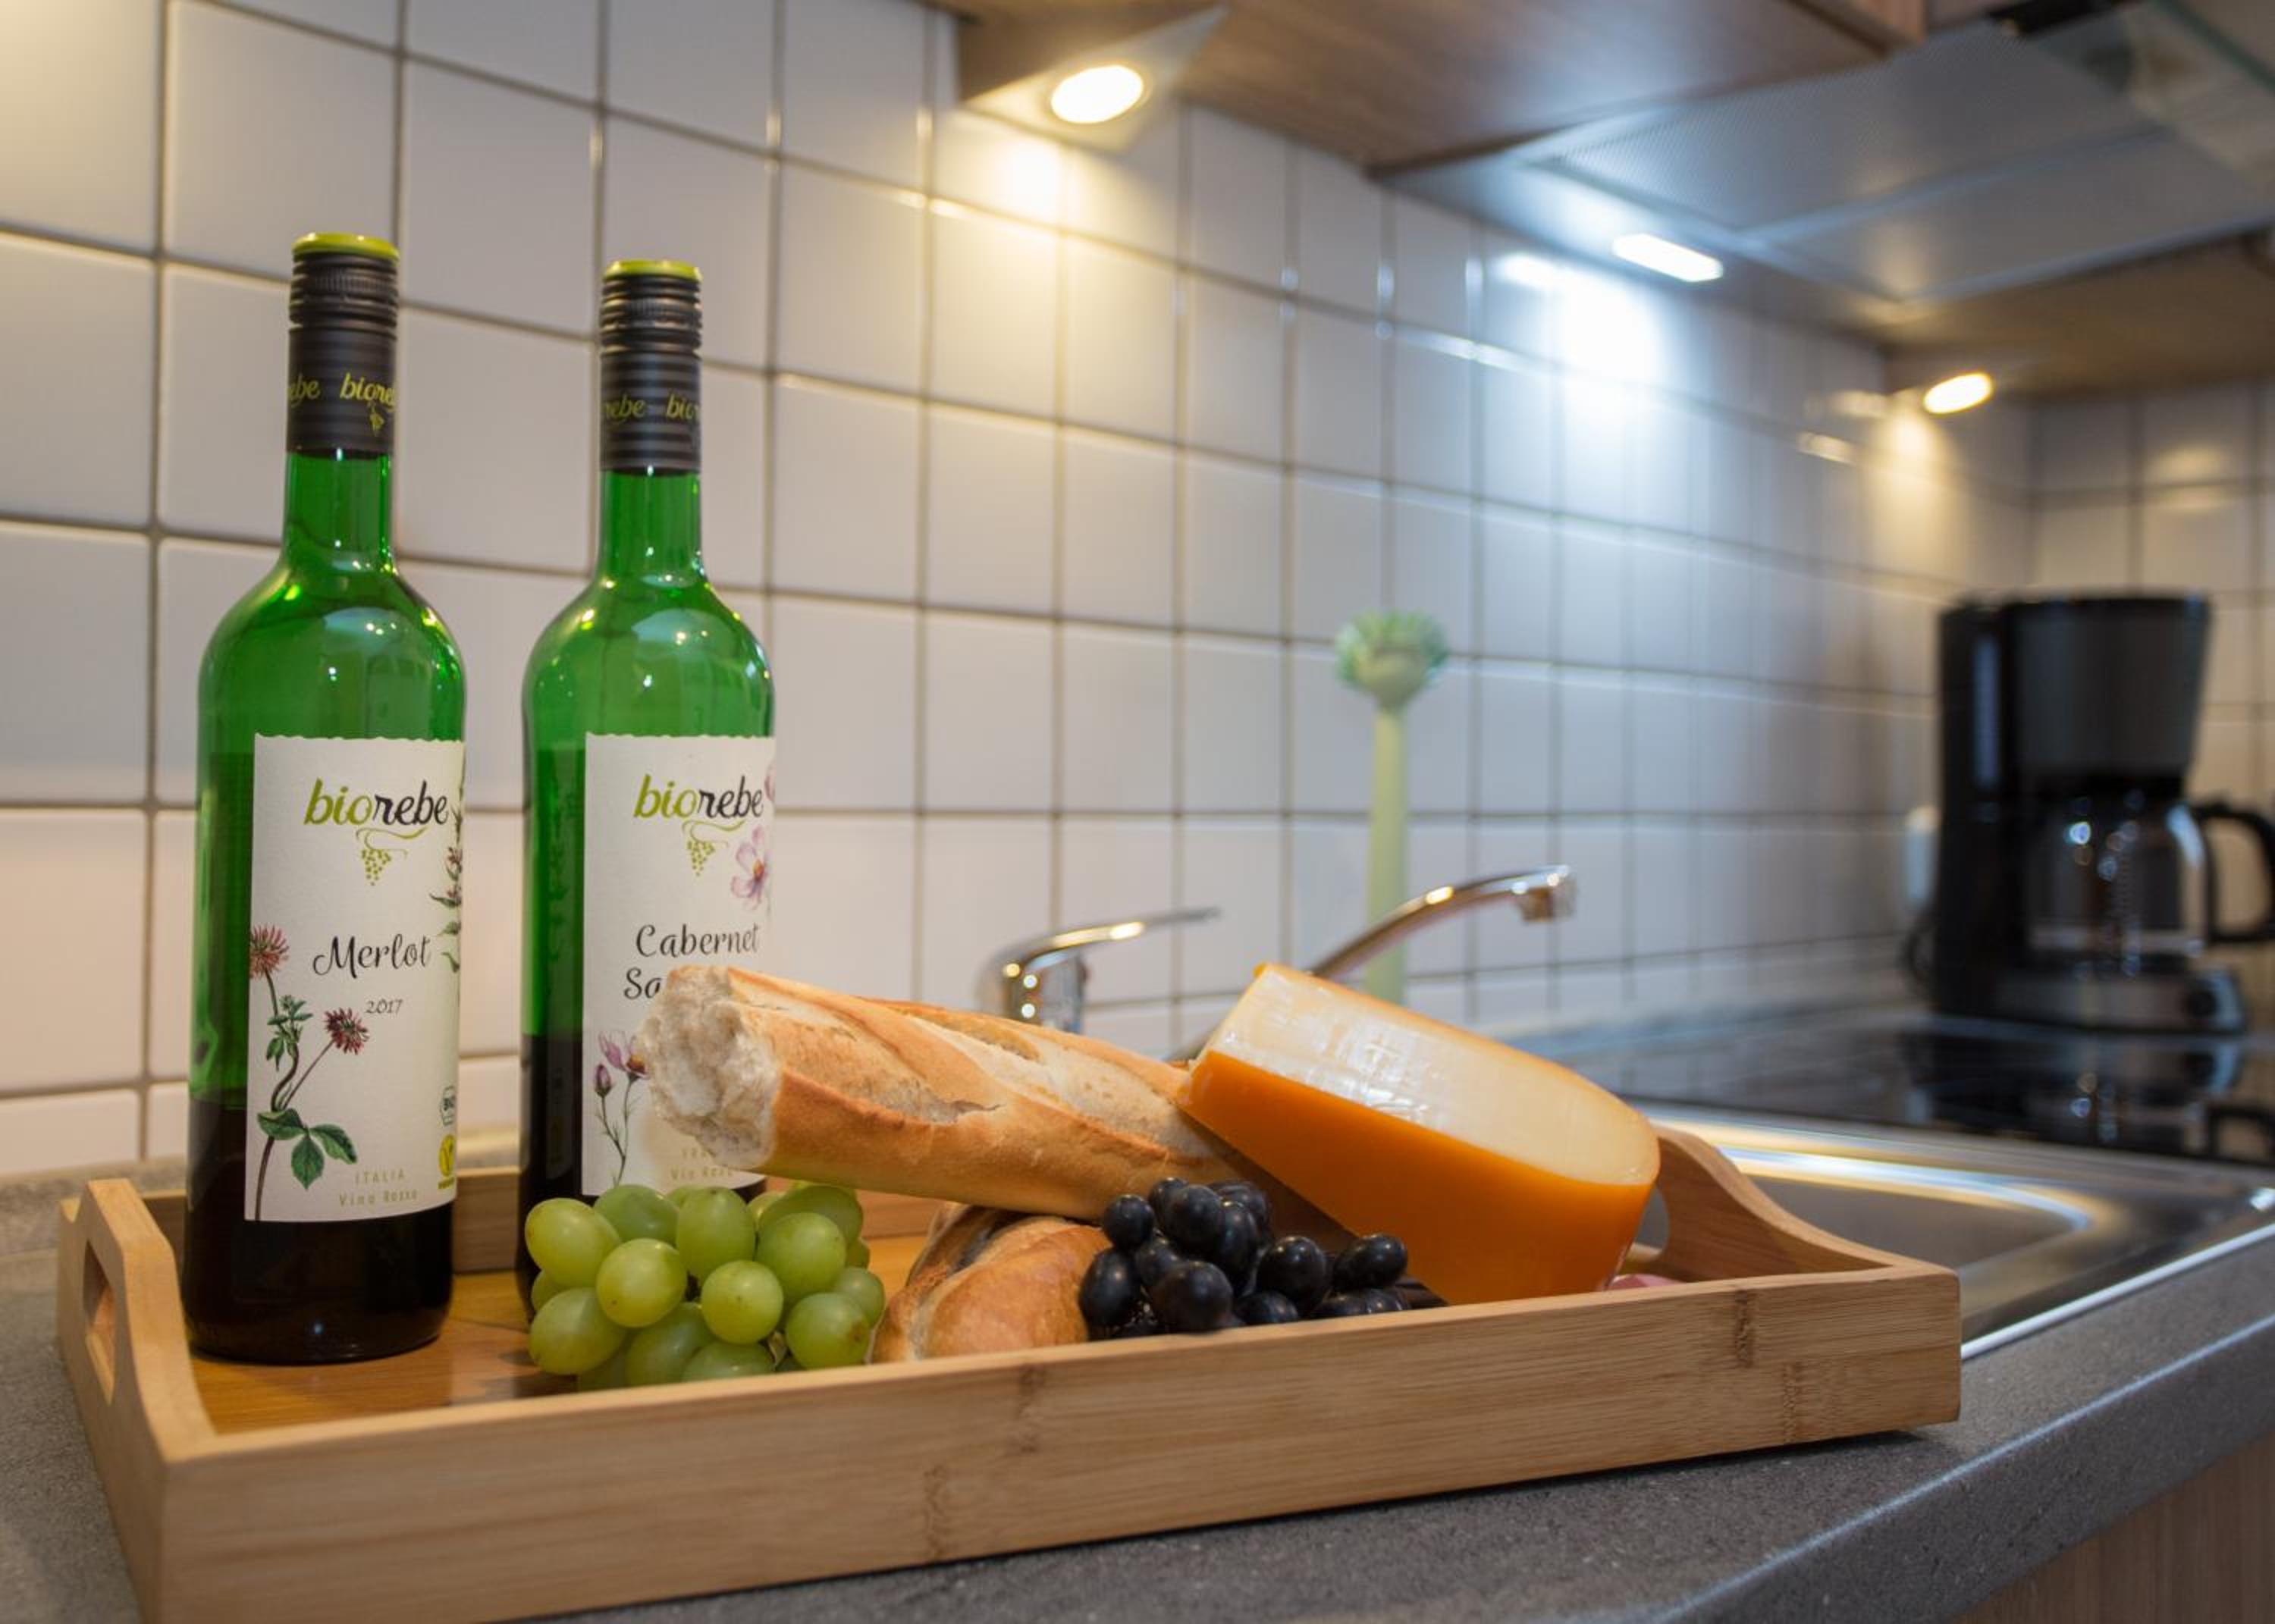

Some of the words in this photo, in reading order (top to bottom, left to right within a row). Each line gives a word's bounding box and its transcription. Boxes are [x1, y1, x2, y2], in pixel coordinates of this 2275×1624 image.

[304, 777, 449, 826] biorebe
[634, 773, 764, 819] biorebe
[312, 933, 432, 980] Merlot
[635, 923, 760, 958] Cabernet
[623, 967, 664, 1000] Sa
[365, 999, 403, 1014] 2017
[354, 1168, 405, 1184] ITALIA
